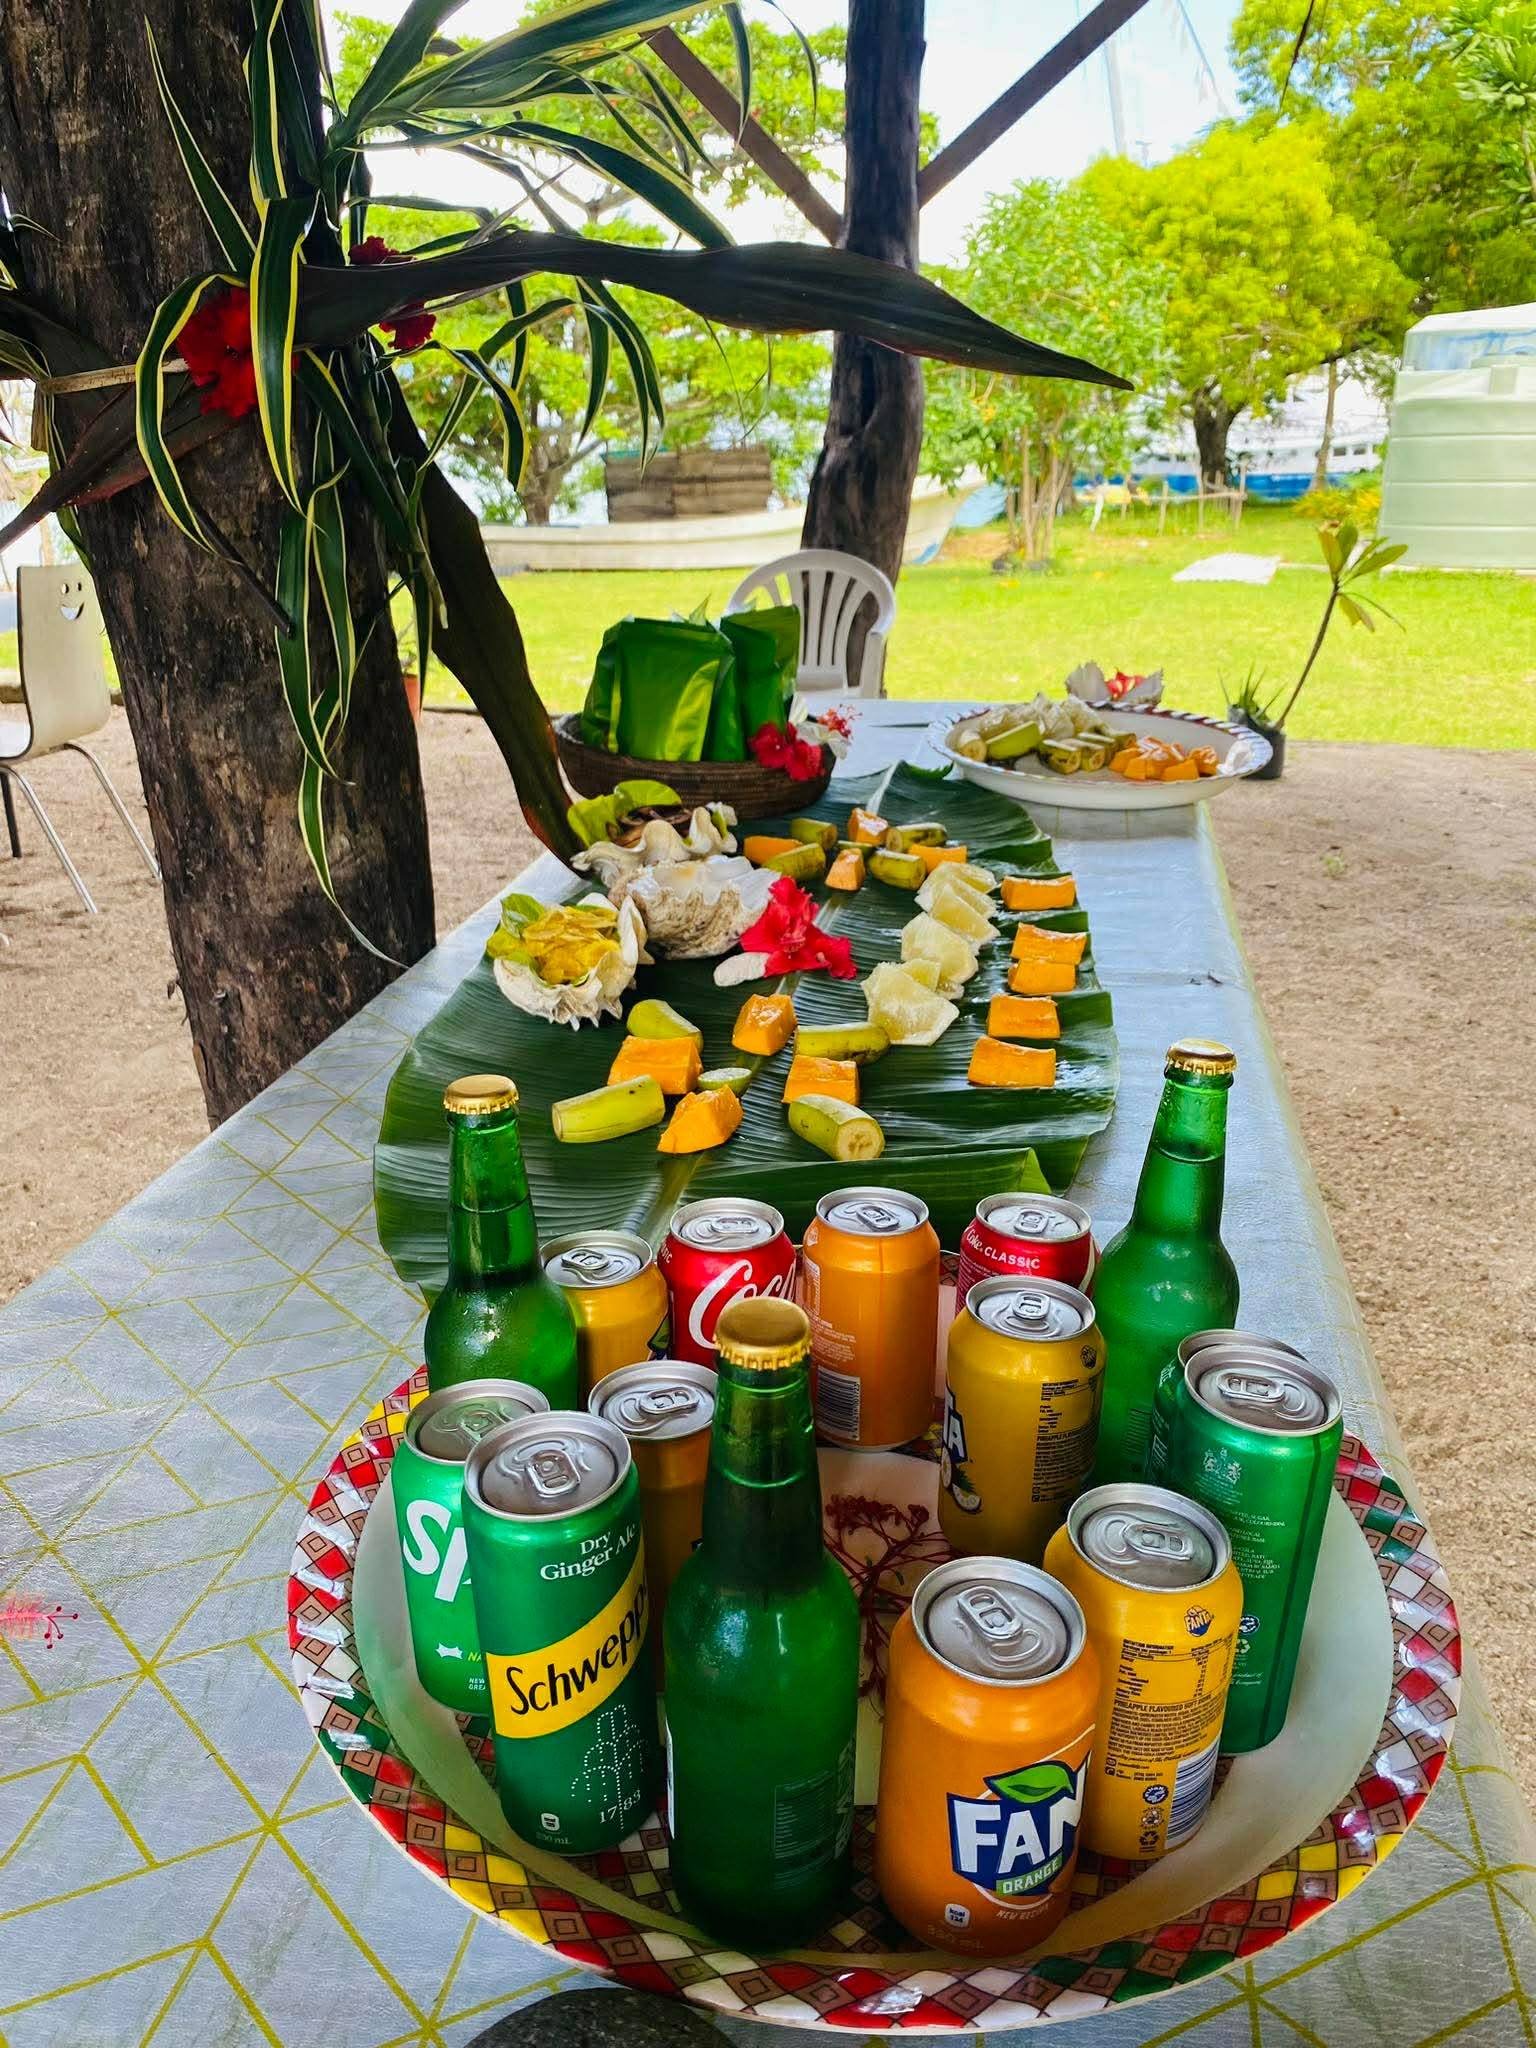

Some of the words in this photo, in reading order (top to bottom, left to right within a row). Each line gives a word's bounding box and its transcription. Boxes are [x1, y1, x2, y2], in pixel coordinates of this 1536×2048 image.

[984, 1246, 1041, 1270] CLASSIC
[540, 1546, 613, 1581] Ginger
[615, 1522, 636, 1555] Ale
[579, 1529, 611, 1555] Dry
[506, 1582, 647, 1716] Schwepp
[1002, 1858, 1059, 1894] ORANGE
[949, 1907, 966, 1918] kcal
